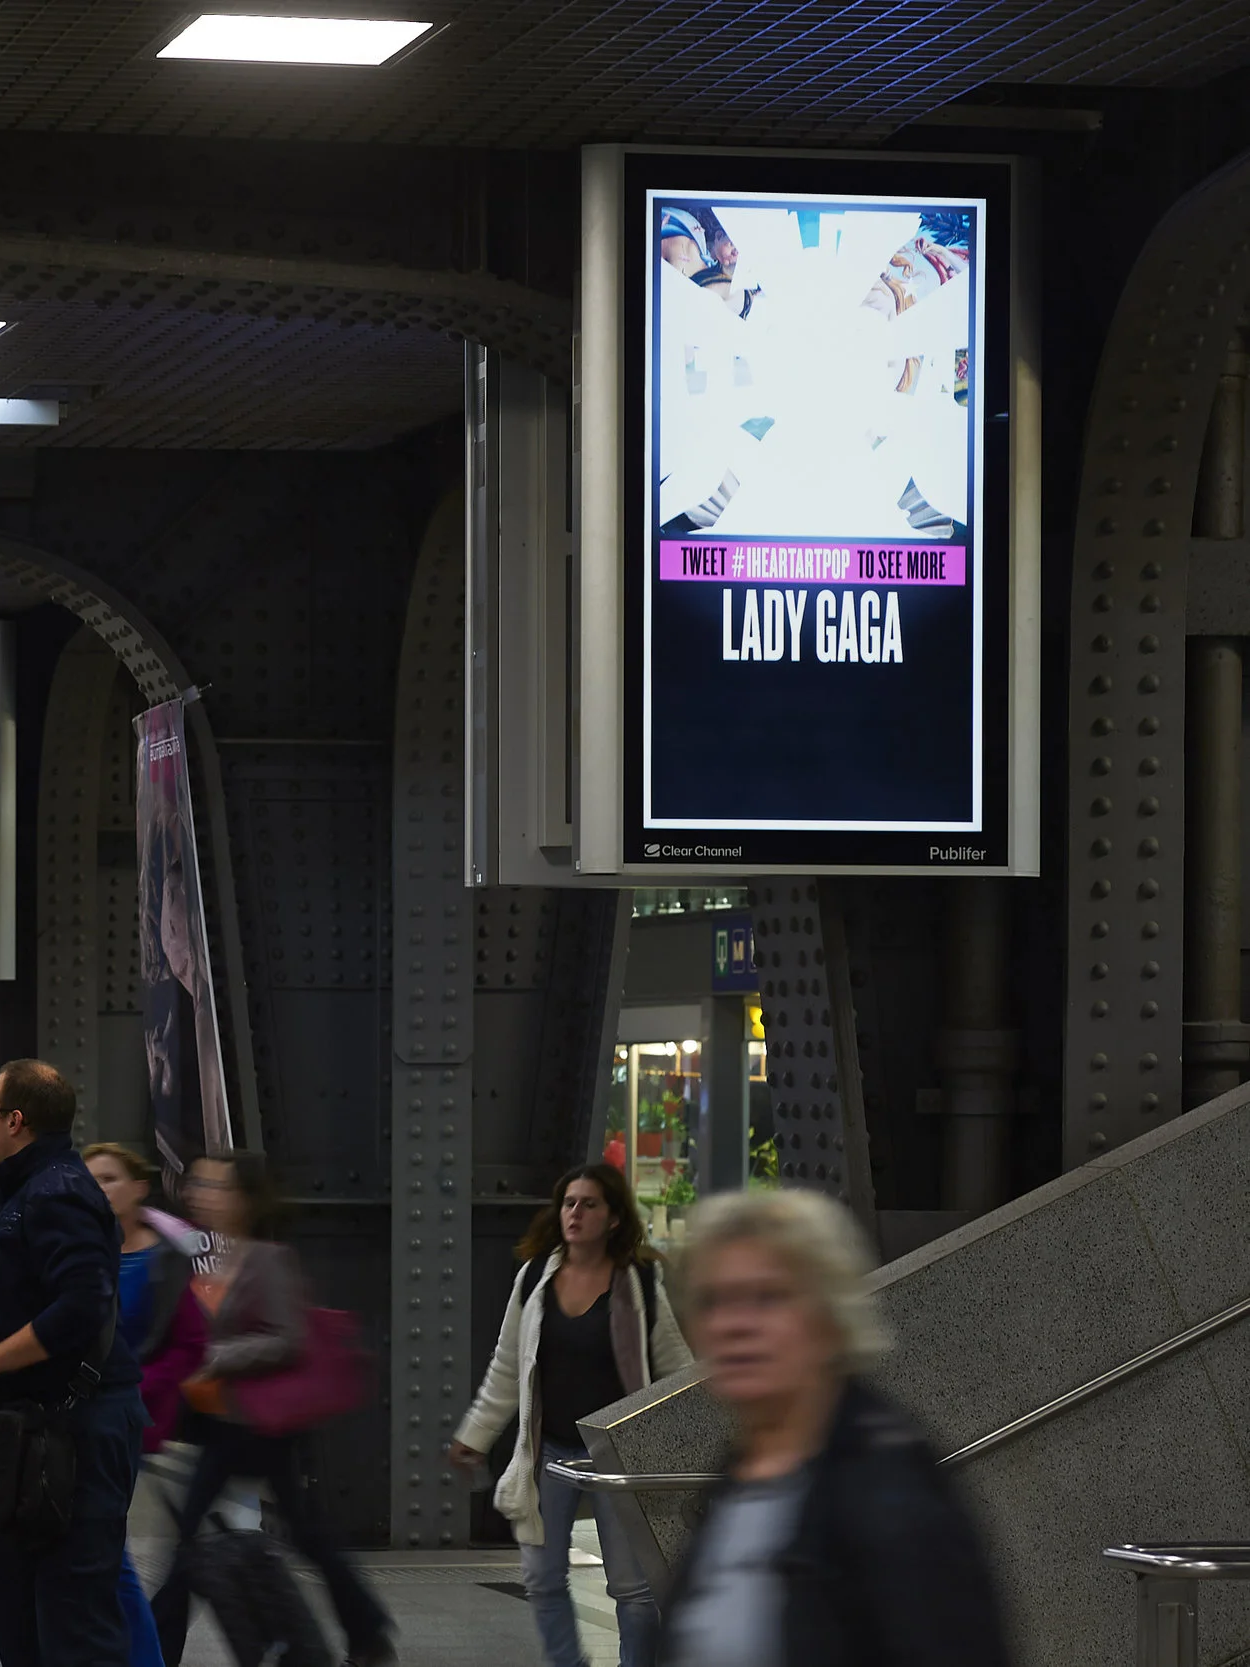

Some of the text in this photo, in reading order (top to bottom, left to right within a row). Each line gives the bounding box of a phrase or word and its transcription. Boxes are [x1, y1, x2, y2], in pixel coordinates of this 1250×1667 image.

[680, 546, 947, 580] TWEET #IHEARTARTPOP TO SEE MORE
[722, 588, 904, 664] LADY GAGA
[661, 844, 742, 858] Clear Channel
[929, 846, 987, 860] Publifer
